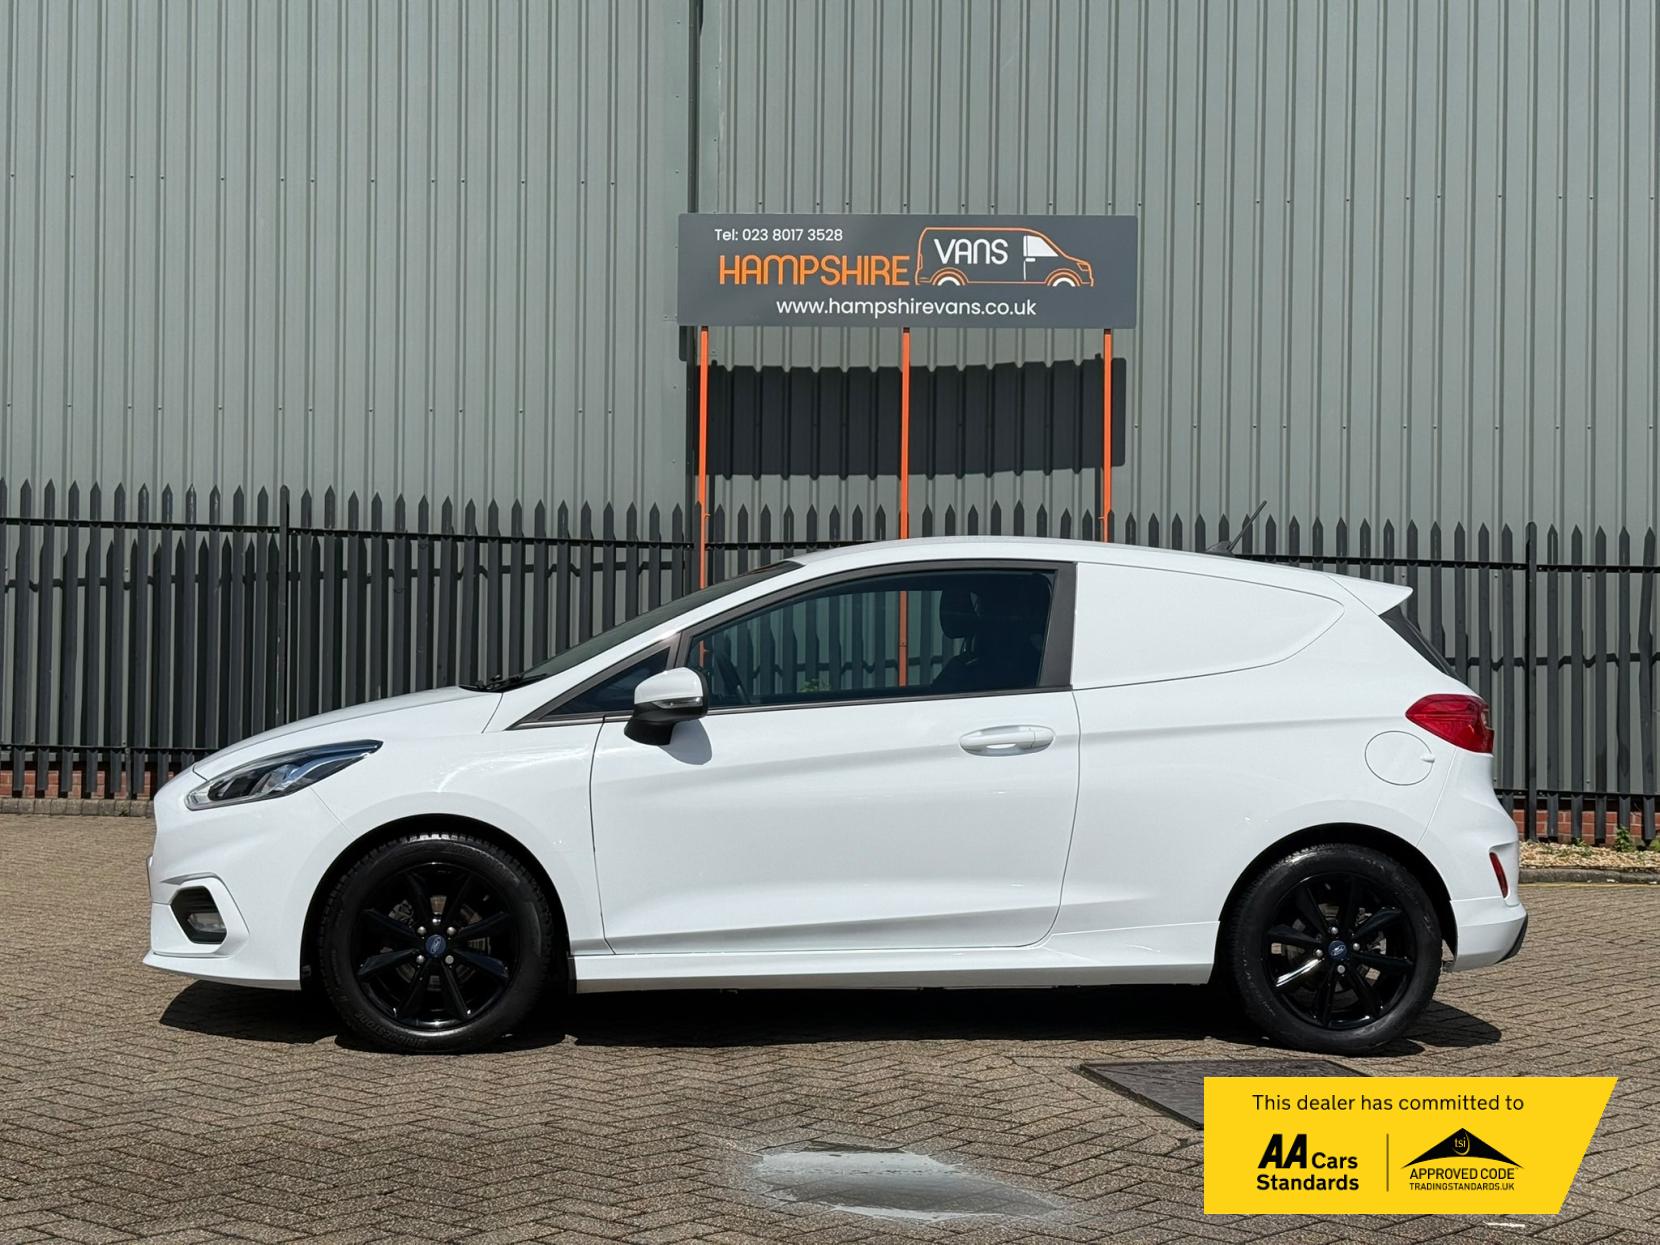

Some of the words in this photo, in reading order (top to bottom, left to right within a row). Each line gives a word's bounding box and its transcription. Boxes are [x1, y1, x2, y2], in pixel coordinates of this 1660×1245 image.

[714, 228, 739, 241] Tel:
[742, 228, 769, 241] 023
[772, 228, 804, 241] 8017
[807, 228, 844, 241] 3528
[719, 254, 910, 286] HAMPSHIRE
[933, 238, 1009, 265] VANS
[775, 297, 1037, 320] www.hampshirevans.co.uk
